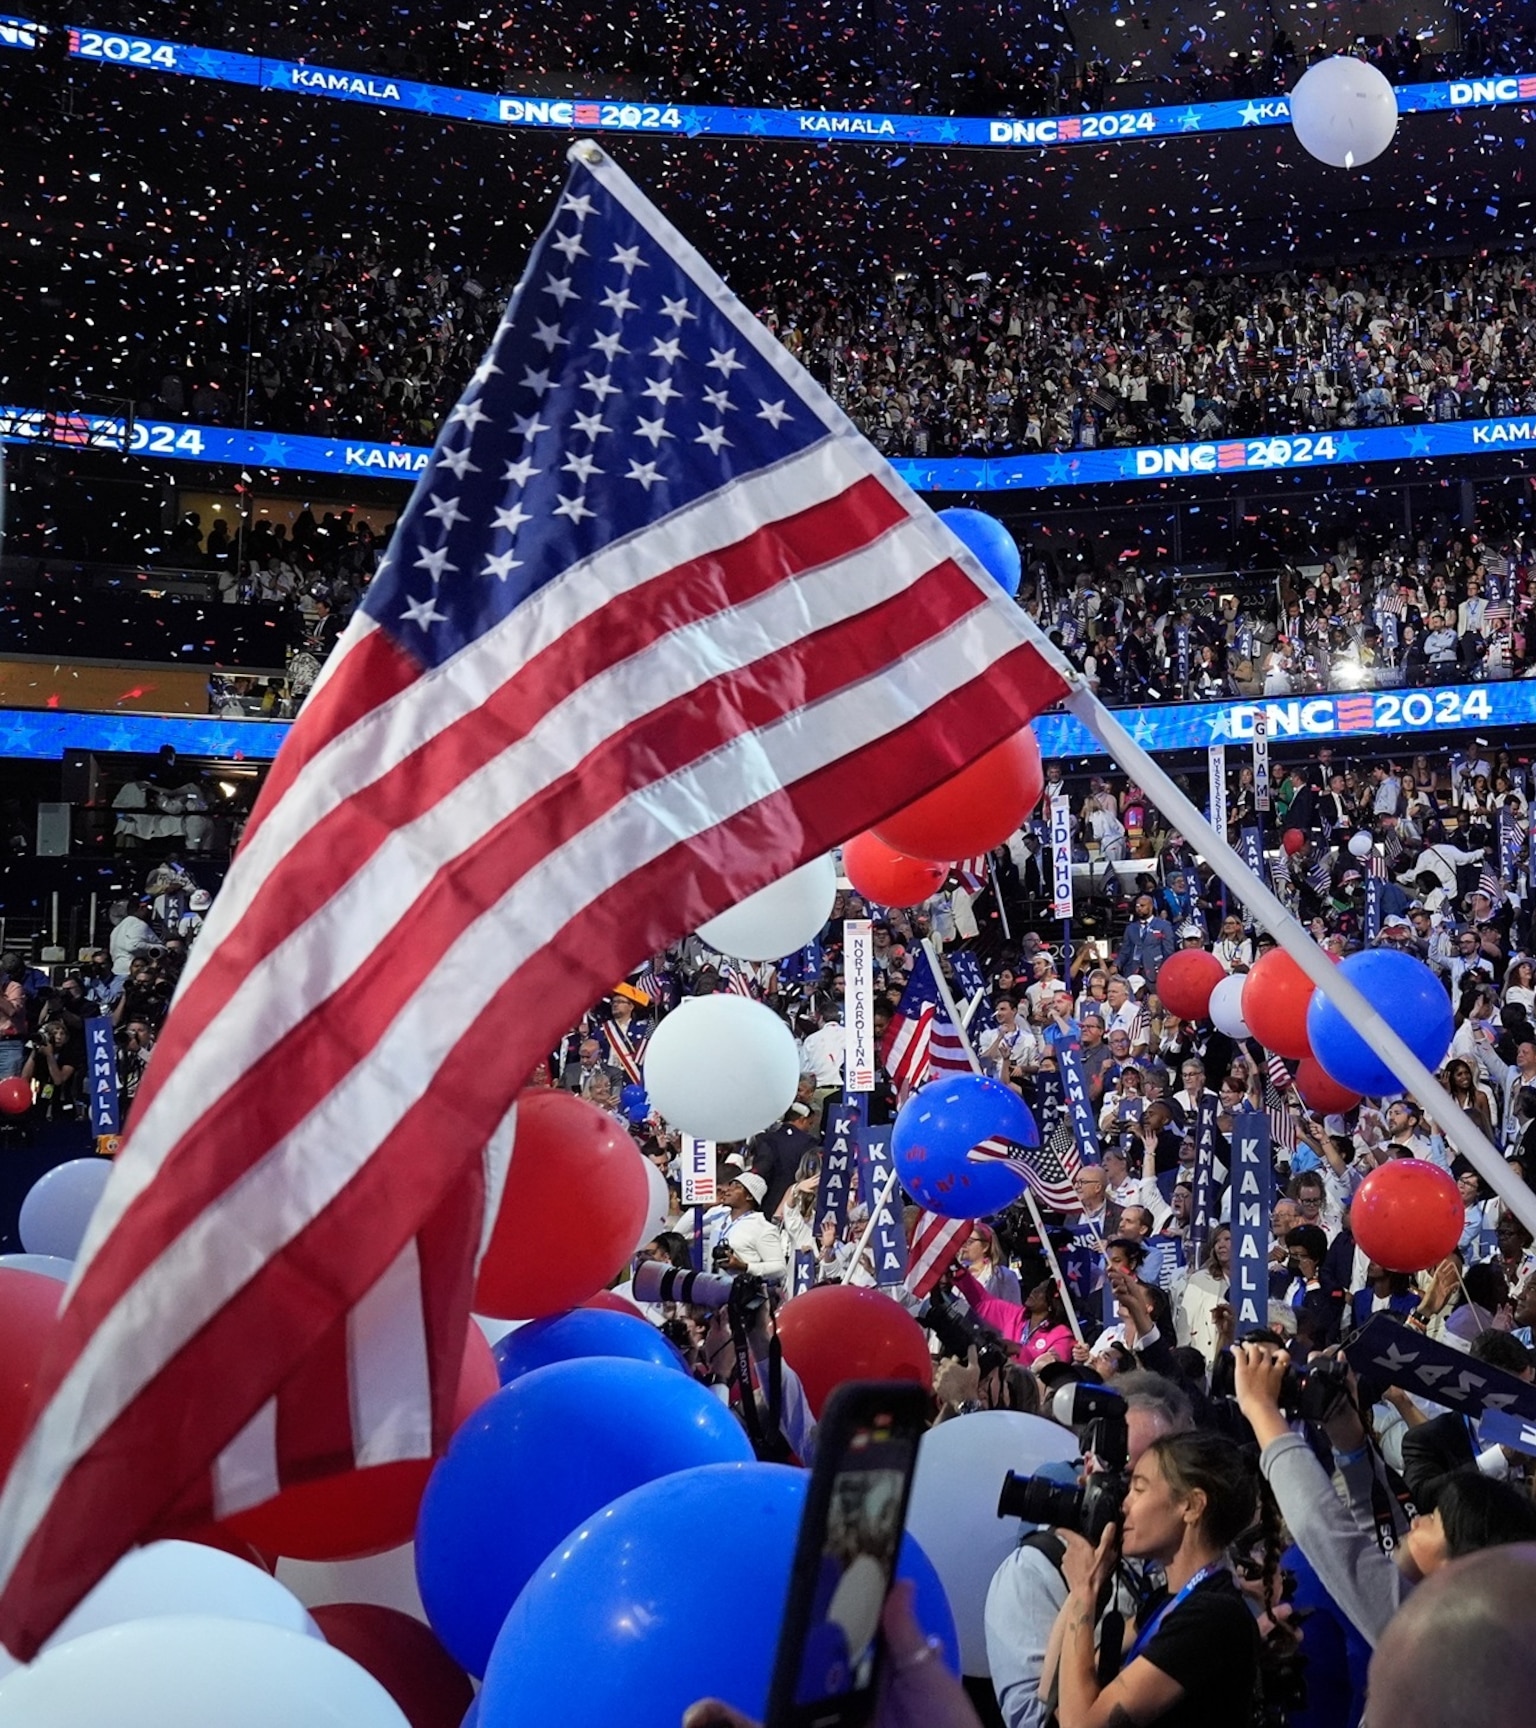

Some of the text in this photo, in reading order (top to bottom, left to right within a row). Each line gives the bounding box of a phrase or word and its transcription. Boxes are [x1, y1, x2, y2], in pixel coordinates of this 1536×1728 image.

[78, 34, 176, 68] 2024
[291, 69, 400, 101] KAMALA
[1450, 80, 1518, 104] DNC
[500, 99, 680, 129] DNC 2024
[800, 115, 895, 136] KAMALA
[989, 112, 1155, 143] DNC 2024
[90, 420, 205, 456] 2024
[1136, 436, 1336, 476] DNC 2024
[1176, 631, 1186, 681] KAMALA
[1231, 688, 1492, 736] DNC 2024
[1254, 723, 1269, 797] GUAM
[1213, 757, 1223, 834] MISSISSIPP
[1054, 810, 1070, 899] IDAHO
[854, 939, 865, 1068] NORTH CAROLINA
[93, 1030, 113, 1127] KAMALA
[1062, 1050, 1096, 1155] KAMALA
[685, 1179, 694, 1202] DNC
[821, 1119, 851, 1224] KAMALA
[1198, 1109, 1209, 1227] KAMALA
[869, 1142, 900, 1271] KAMALA
[1240, 1137, 1261, 1324] KAMALA
[1073, 1232, 1098, 1250] RIS
[1156, 1241, 1179, 1293] HARR
